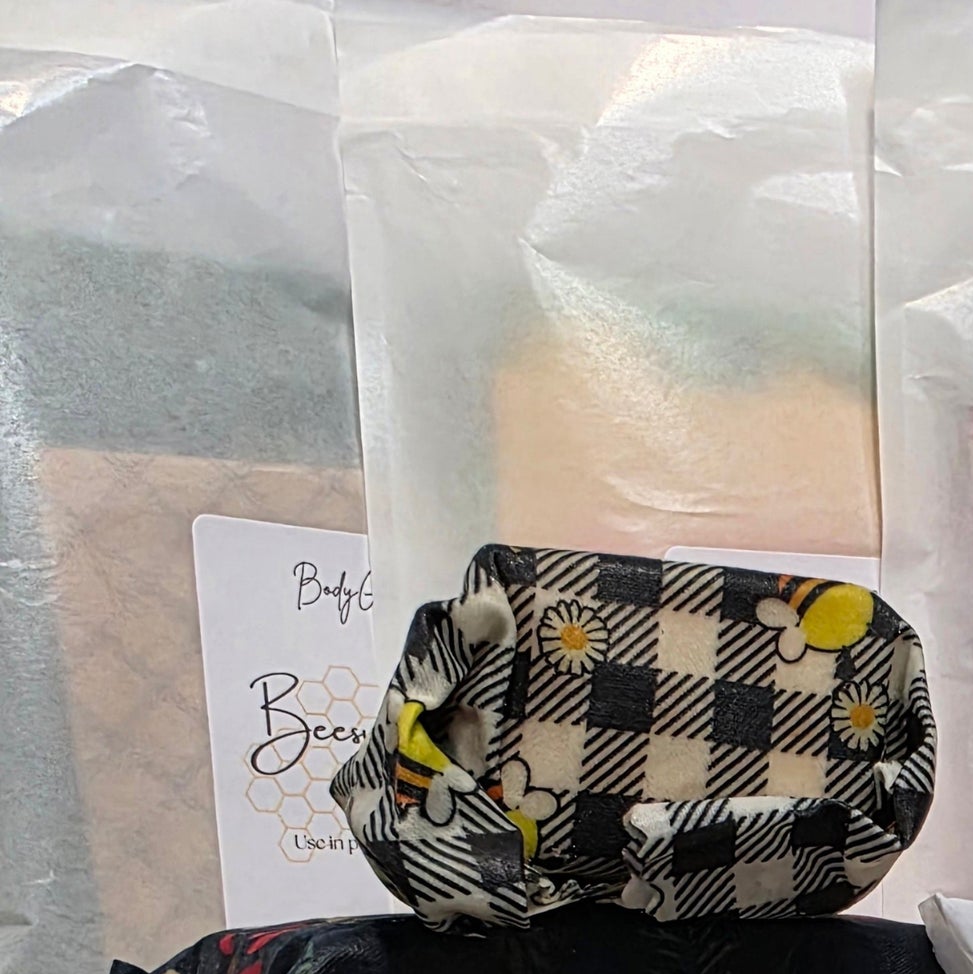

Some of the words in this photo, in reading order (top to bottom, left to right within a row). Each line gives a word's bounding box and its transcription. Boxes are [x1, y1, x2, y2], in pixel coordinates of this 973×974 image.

[250, 672, 366, 775] Bees
[294, 833, 325, 851] Use
[328, 836, 344, 852] in
